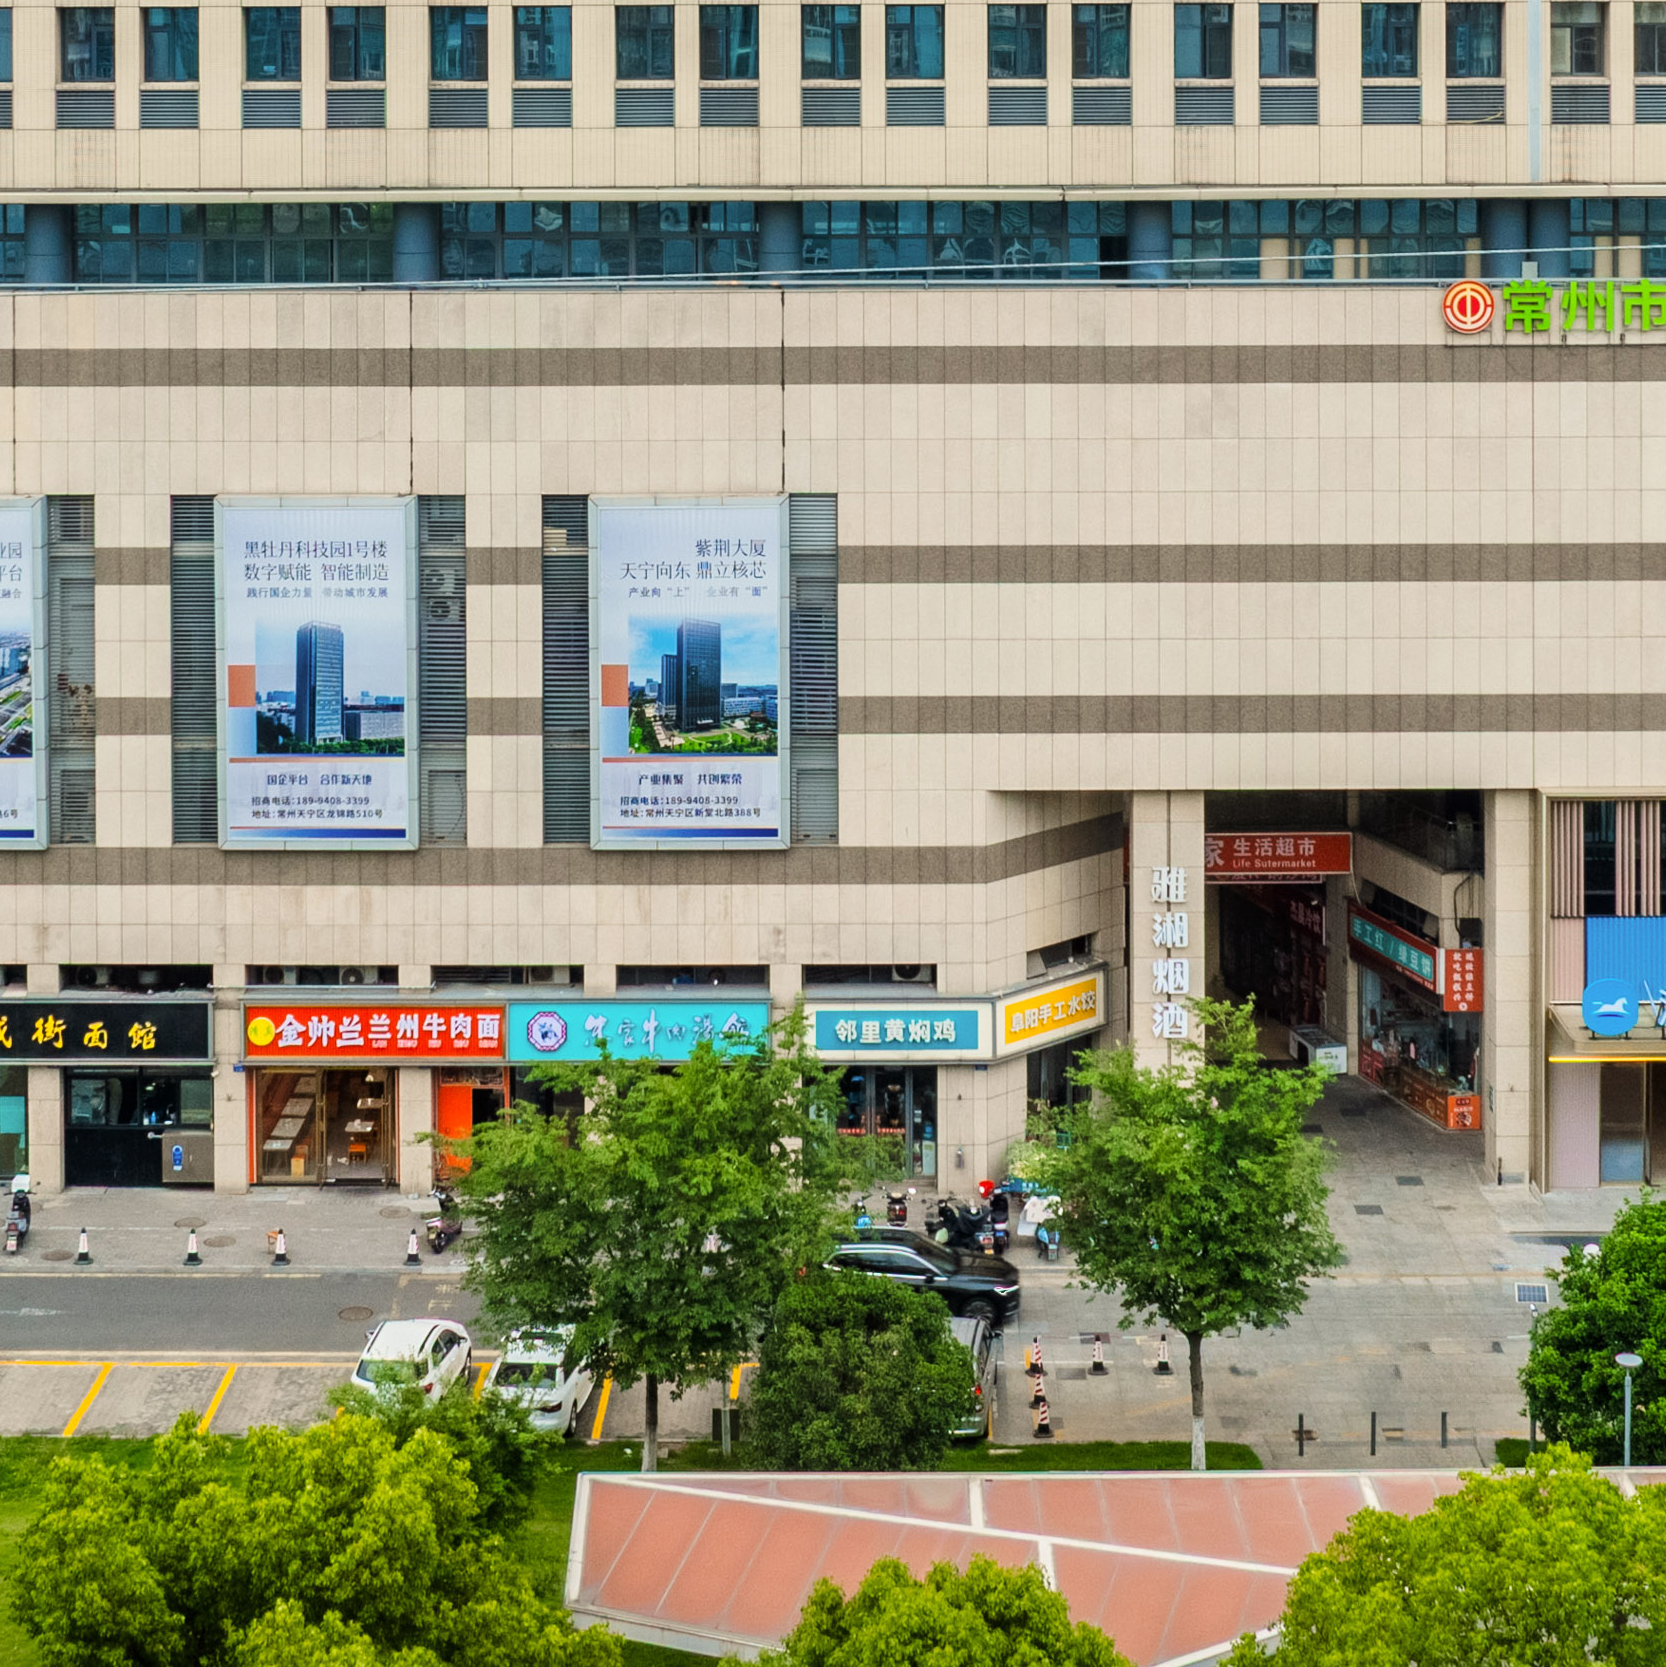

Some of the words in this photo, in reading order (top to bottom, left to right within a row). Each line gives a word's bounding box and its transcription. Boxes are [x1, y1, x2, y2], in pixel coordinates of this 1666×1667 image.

[244, 540, 388, 559] 黑牡丹科技园1号楼
[696, 539, 767, 557] 紫荆大厦
[244, 563, 312, 581] 数字赋能
[321, 563, 389, 581] 智能制造
[620, 561, 691, 580] 天宁向东
[1233, 837, 1316, 857] 生活超市
[1233, 859, 1251, 868] Life
[1151, 866, 1189, 1040] 雅湘烟酒
[1010, 990, 1096, 1033] 阜阳手工水饺
[367, 1013, 501, 1040] 兰州牛肉面
[835, 1018, 957, 1044] 邻里黄焖鸡
